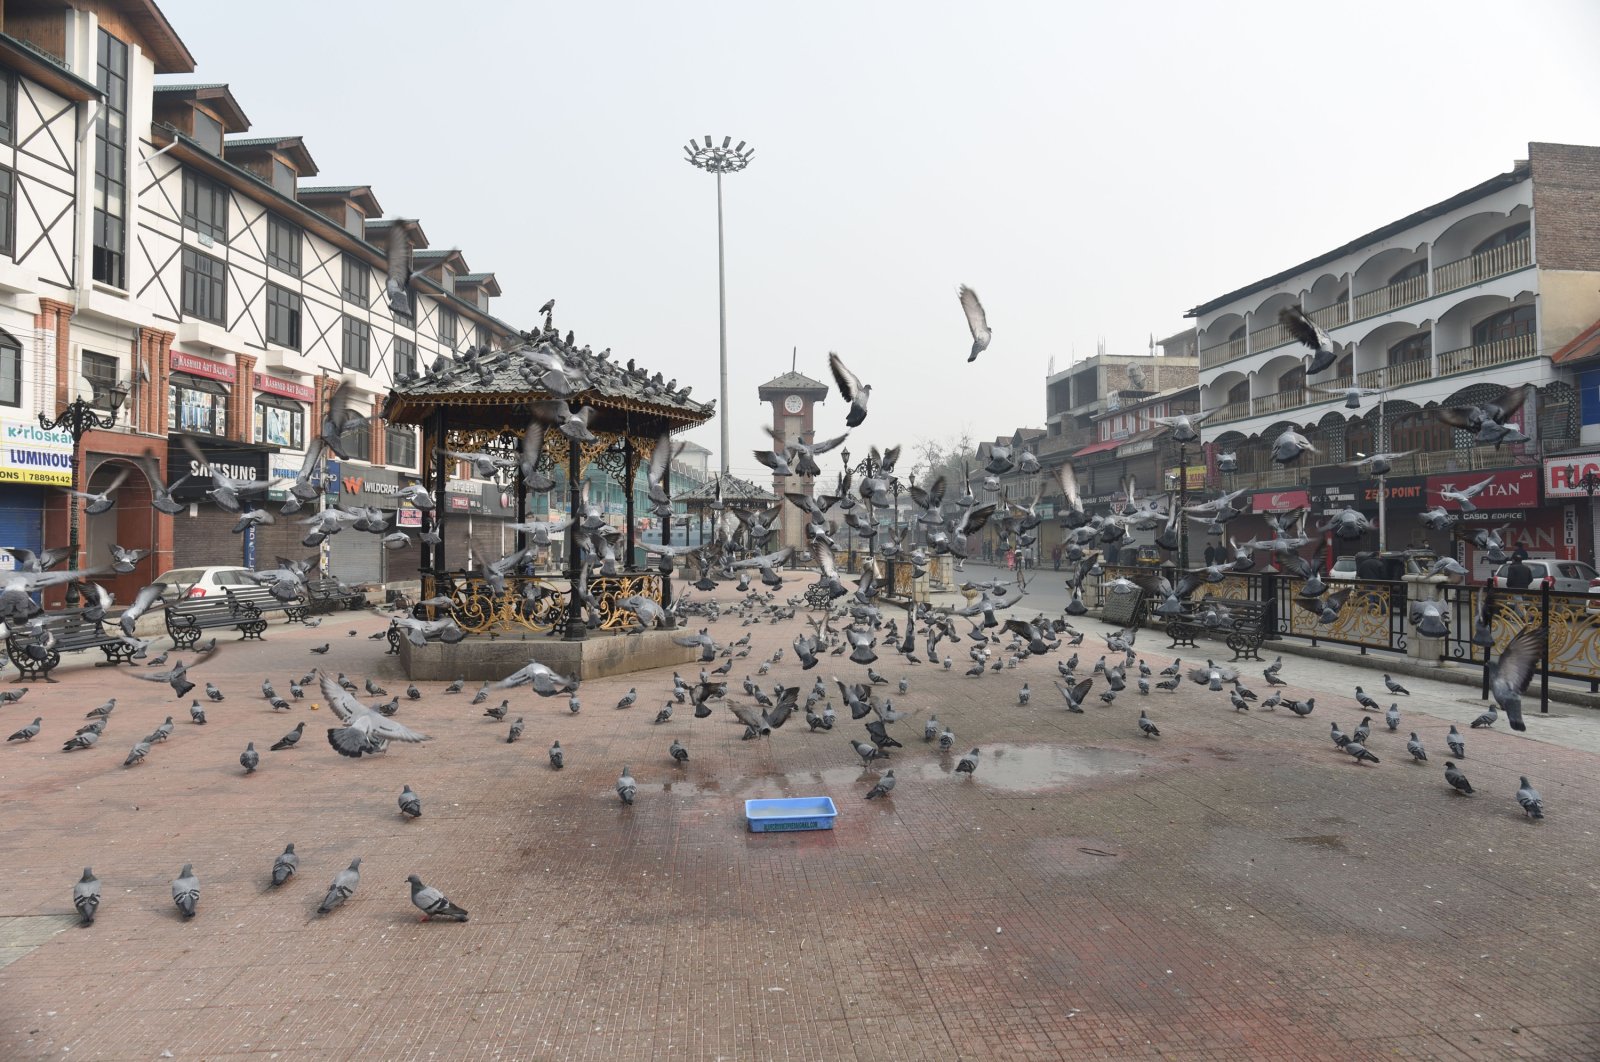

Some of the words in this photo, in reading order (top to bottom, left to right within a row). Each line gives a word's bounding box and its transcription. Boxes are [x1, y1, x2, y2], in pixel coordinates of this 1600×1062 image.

[11, 449, 73, 468] LUMINOUS
[190, 460, 257, 481] SAMSUNG
[364, 481, 399, 494] WILDCRAFT
[1364, 488, 1390, 500] ZEO
[1391, 487, 1421, 498] POINT
[1491, 512, 1522, 520] EDIFICE
